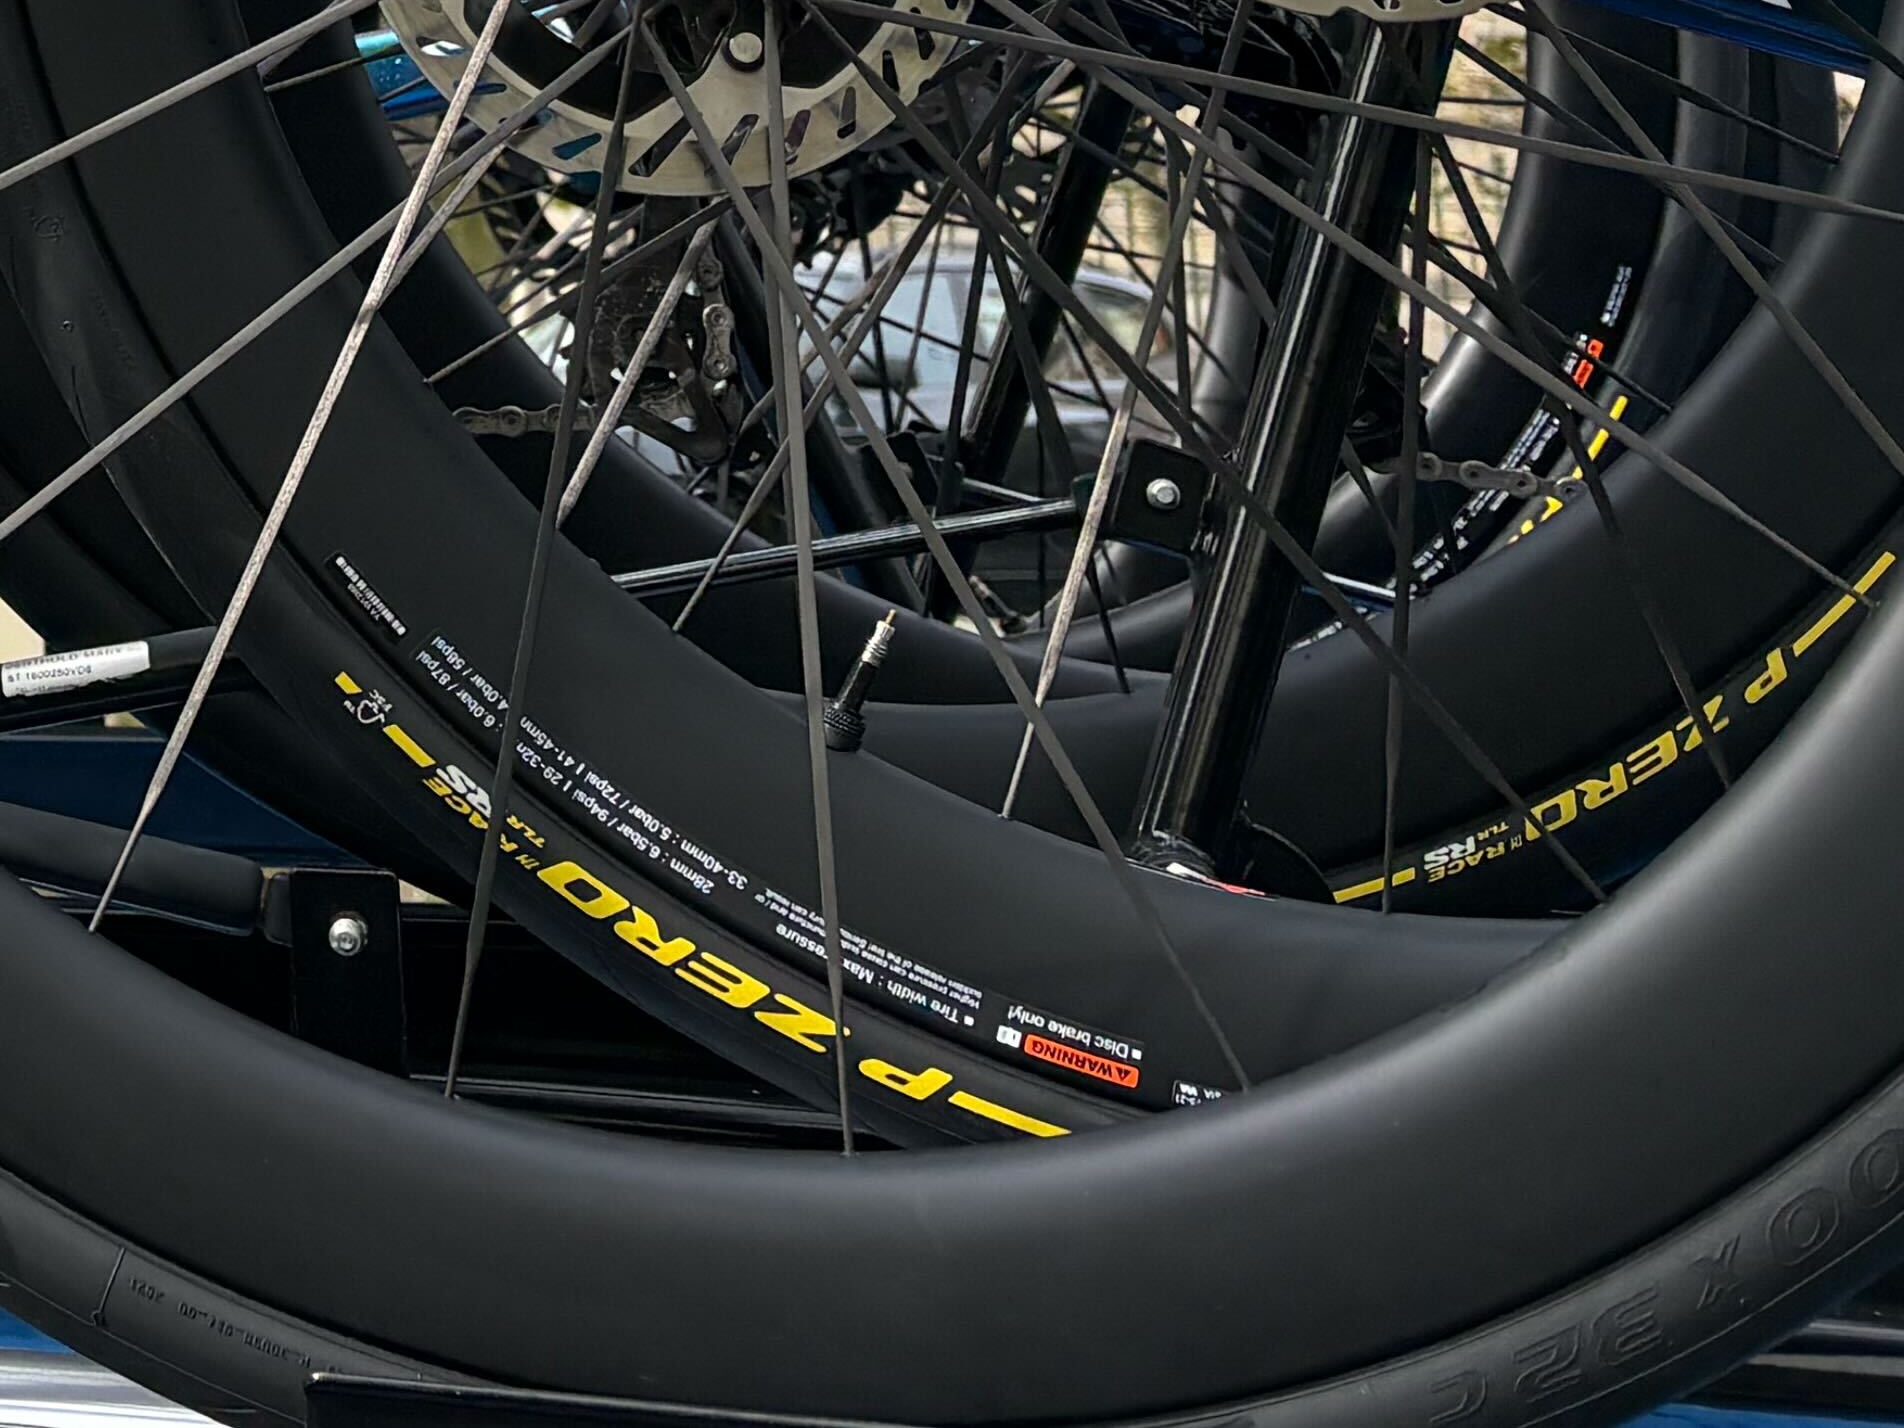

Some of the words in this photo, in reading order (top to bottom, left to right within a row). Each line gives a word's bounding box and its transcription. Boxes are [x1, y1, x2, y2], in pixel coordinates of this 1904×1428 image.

[415, 650, 452, 685] 87psi
[431, 634, 467, 671] 58psi
[471, 671, 511, 712] 4.0bar
[1743, 647, 1789, 704] P
[455, 688, 497, 730] 6.0bar
[586, 770, 622, 802] 72psi
[1523, 694, 1731, 842] ZERO
[435, 764, 494, 820] RS
[570, 787, 604, 820] 94psi
[505, 814, 546, 849] TLR
[616, 823, 661, 861] 6.5bar
[633, 805, 673, 842] 5.0bar
[680, 841, 749, 892] 33-40mm
[1423, 834, 1477, 871] RS
[1427, 841, 1510, 883] RACE
[668, 857, 716, 895] 28mm
[536, 860, 852, 1053] ZERO
[887, 979, 929, 1011] width
[931, 997, 960, 1026] Tire
[1007, 1003, 1045, 1030] only!
[1047, 1020, 1091, 1049] brake
[1029, 1039, 1116, 1077] WARNING
[1092, 1033, 1129, 1059] Disc
[858, 1057, 953, 1101] P
